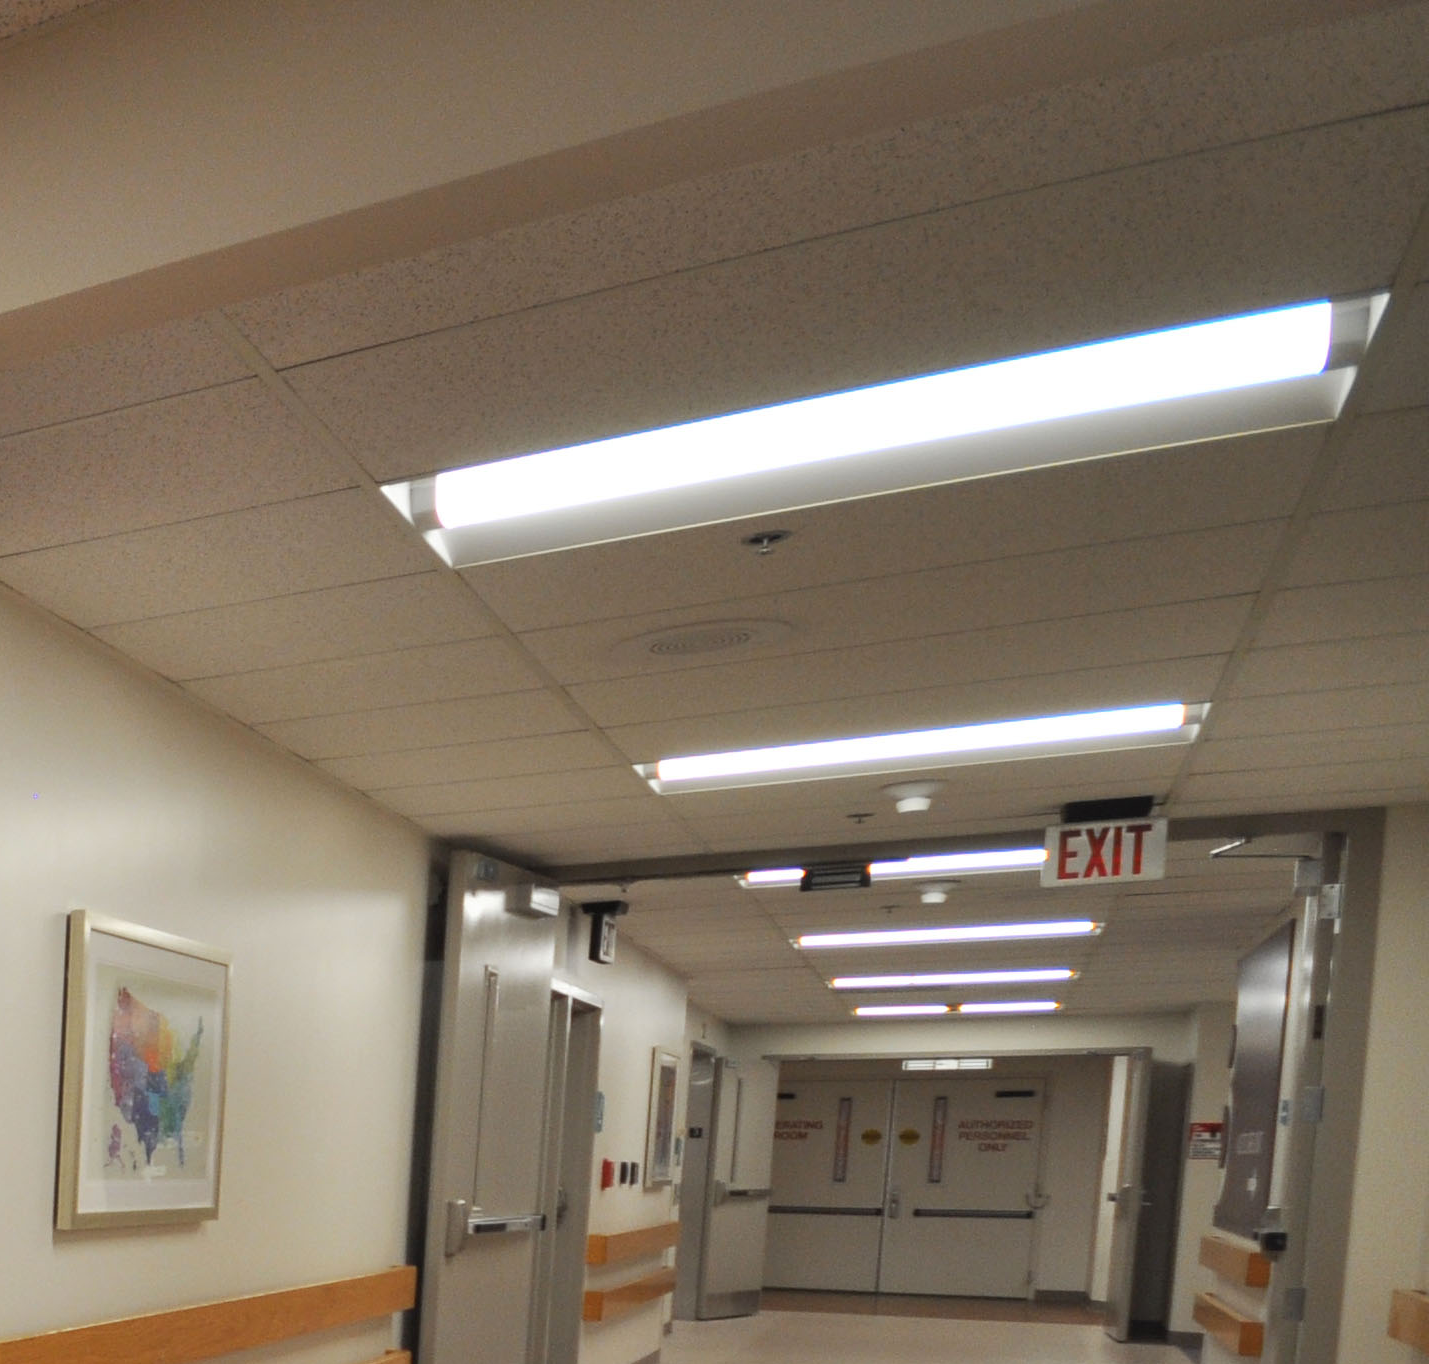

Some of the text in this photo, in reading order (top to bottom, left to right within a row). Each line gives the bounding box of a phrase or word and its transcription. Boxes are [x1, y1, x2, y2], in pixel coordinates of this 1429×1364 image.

[1057, 824, 1153, 880] EXIT
[775, 1120, 823, 1129] ERATING
[958, 1120, 1034, 1129] AUTHORIZED
[773, 1130, 808, 1140] ROOM
[958, 1131, 1030, 1140] PERSONNEL
[978, 1143, 1007, 1152] ONLY
